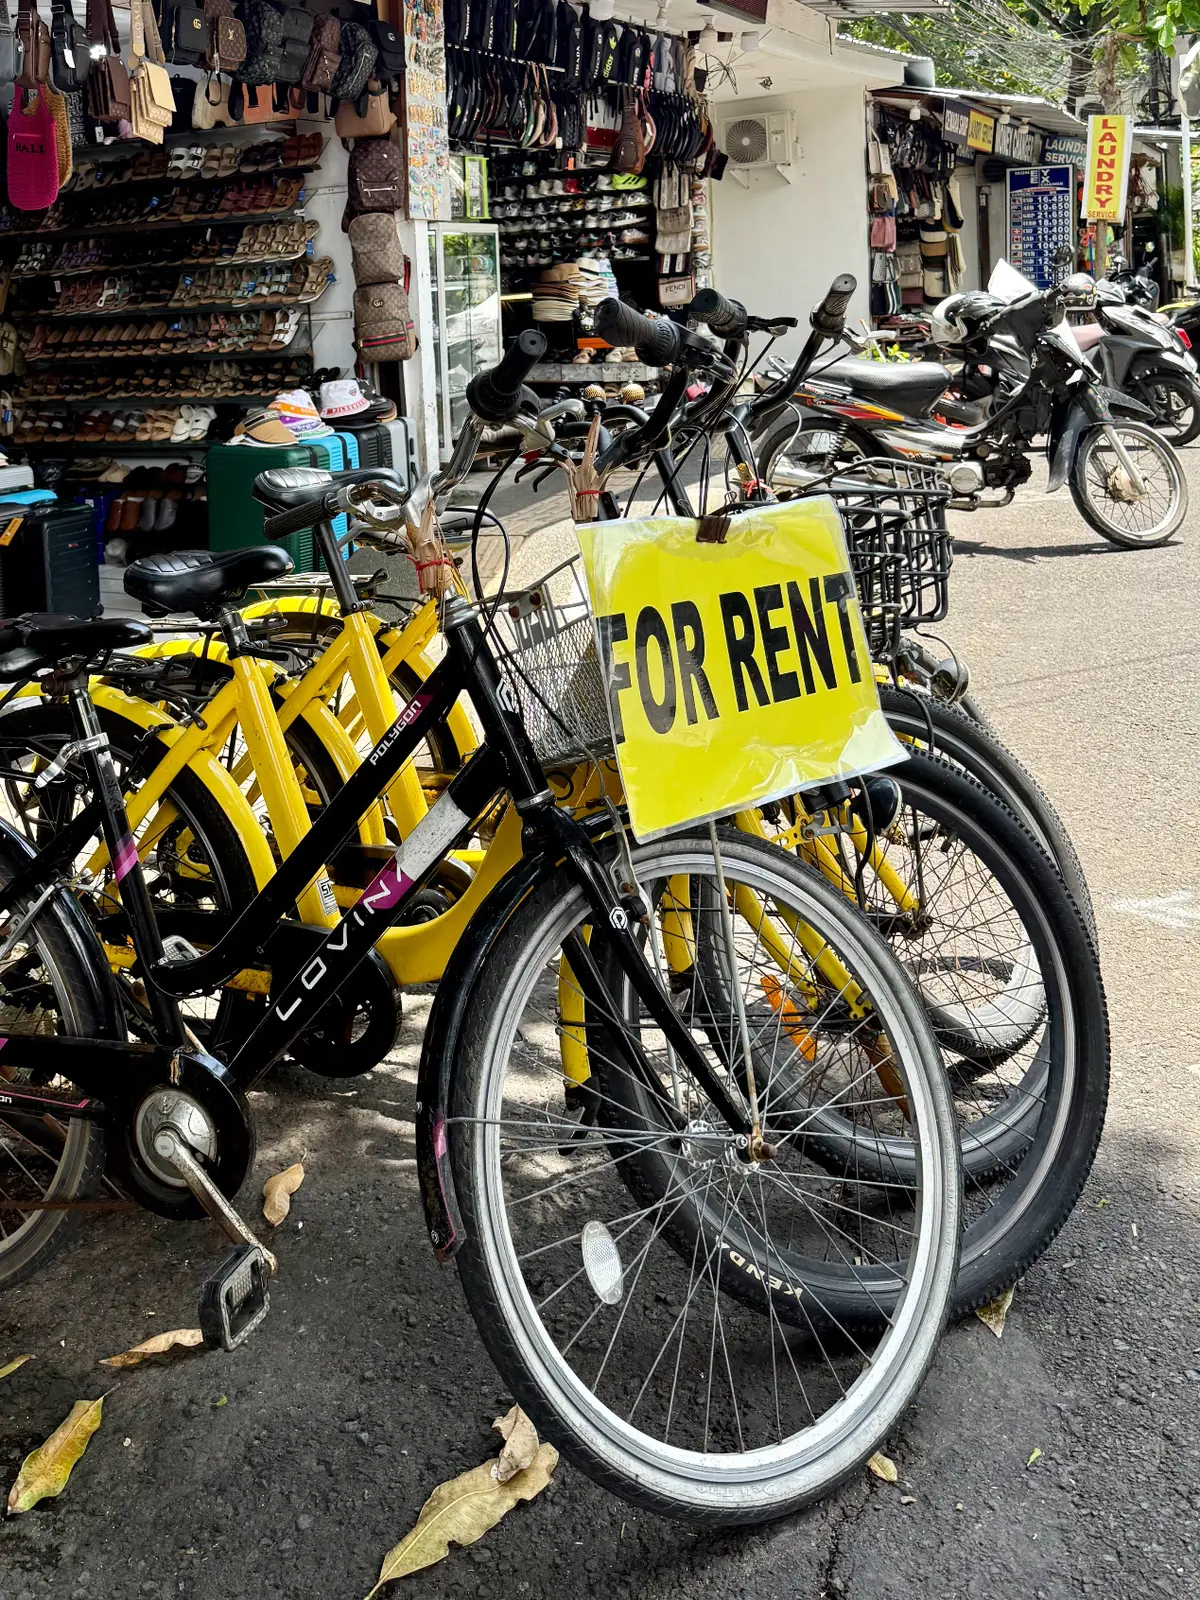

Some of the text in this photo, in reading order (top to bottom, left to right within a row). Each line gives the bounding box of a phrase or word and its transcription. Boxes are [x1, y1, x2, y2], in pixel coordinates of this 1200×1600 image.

[574, 45, 582, 77] PRADA
[16, 142, 45, 155] BALI
[1045, 138, 1087, 155] LAUNDR
[1094, 118, 1117, 208] LAUNDRY
[1038, 195, 1069, 203] 16.450
[1037, 210, 1069, 219] 21.650
[1088, 210, 1117, 219] SERVICE
[1038, 218, 1069, 226] 18.950
[1037, 226, 1069, 234] 20.400
[1038, 234, 1069, 242] 11.600
[665, 284, 686, 293] FENDI
[595, 572, 862, 744] FOR RENT
[715, 1234, 803, 1300] KENDA
